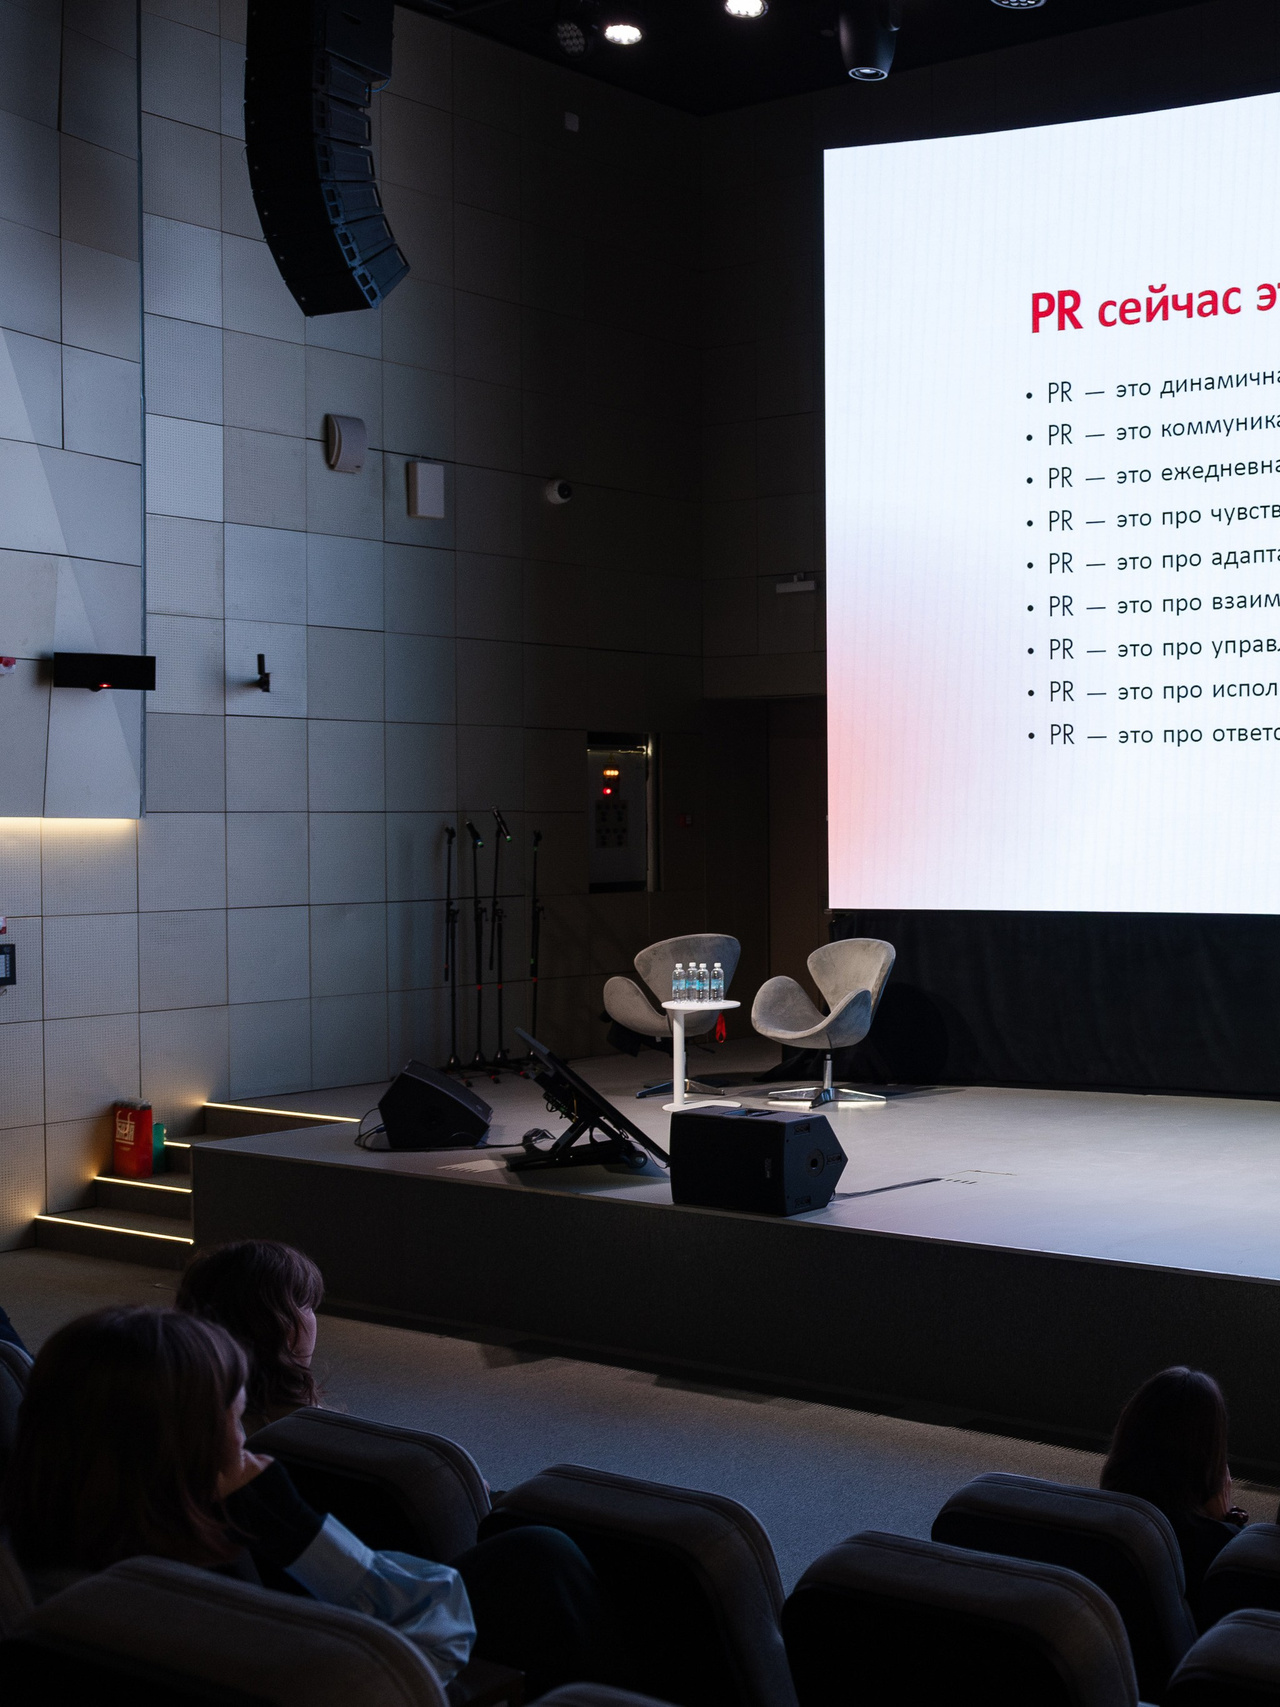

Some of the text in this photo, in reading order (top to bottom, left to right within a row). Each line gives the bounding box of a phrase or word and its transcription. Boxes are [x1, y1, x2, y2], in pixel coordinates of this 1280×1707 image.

[1031, 289, 1084, 334] PR
[1097, 283, 1242, 328] сейчас
[1048, 380, 1073, 404] PR
[1116, 382, 1152, 398] это
[1048, 423, 1073, 446] PR
[1116, 425, 1152, 441] это
[1048, 466, 1073, 489] PR
[1116, 469, 1152, 485] это
[1048, 509, 1074, 532] PR
[1116, 512, 1152, 528] это
[1162, 509, 1202, 529] про
[1049, 551, 1074, 575] PR
[1117, 555, 1153, 571] это
[1162, 553, 1202, 573] про
[1049, 594, 1074, 617] PR
[1117, 599, 1153, 615] это
[1162, 597, 1202, 617] про
[1049, 638, 1074, 660] PR
[1117, 643, 1153, 658] это
[1162, 641, 1203, 661] про
[1050, 680, 1075, 703] PR
[1118, 686, 1153, 701] это
[1163, 684, 1203, 704] про
[1050, 723, 1075, 745] PR
[1118, 729, 1154, 744] это
[1163, 728, 1203, 748] про
